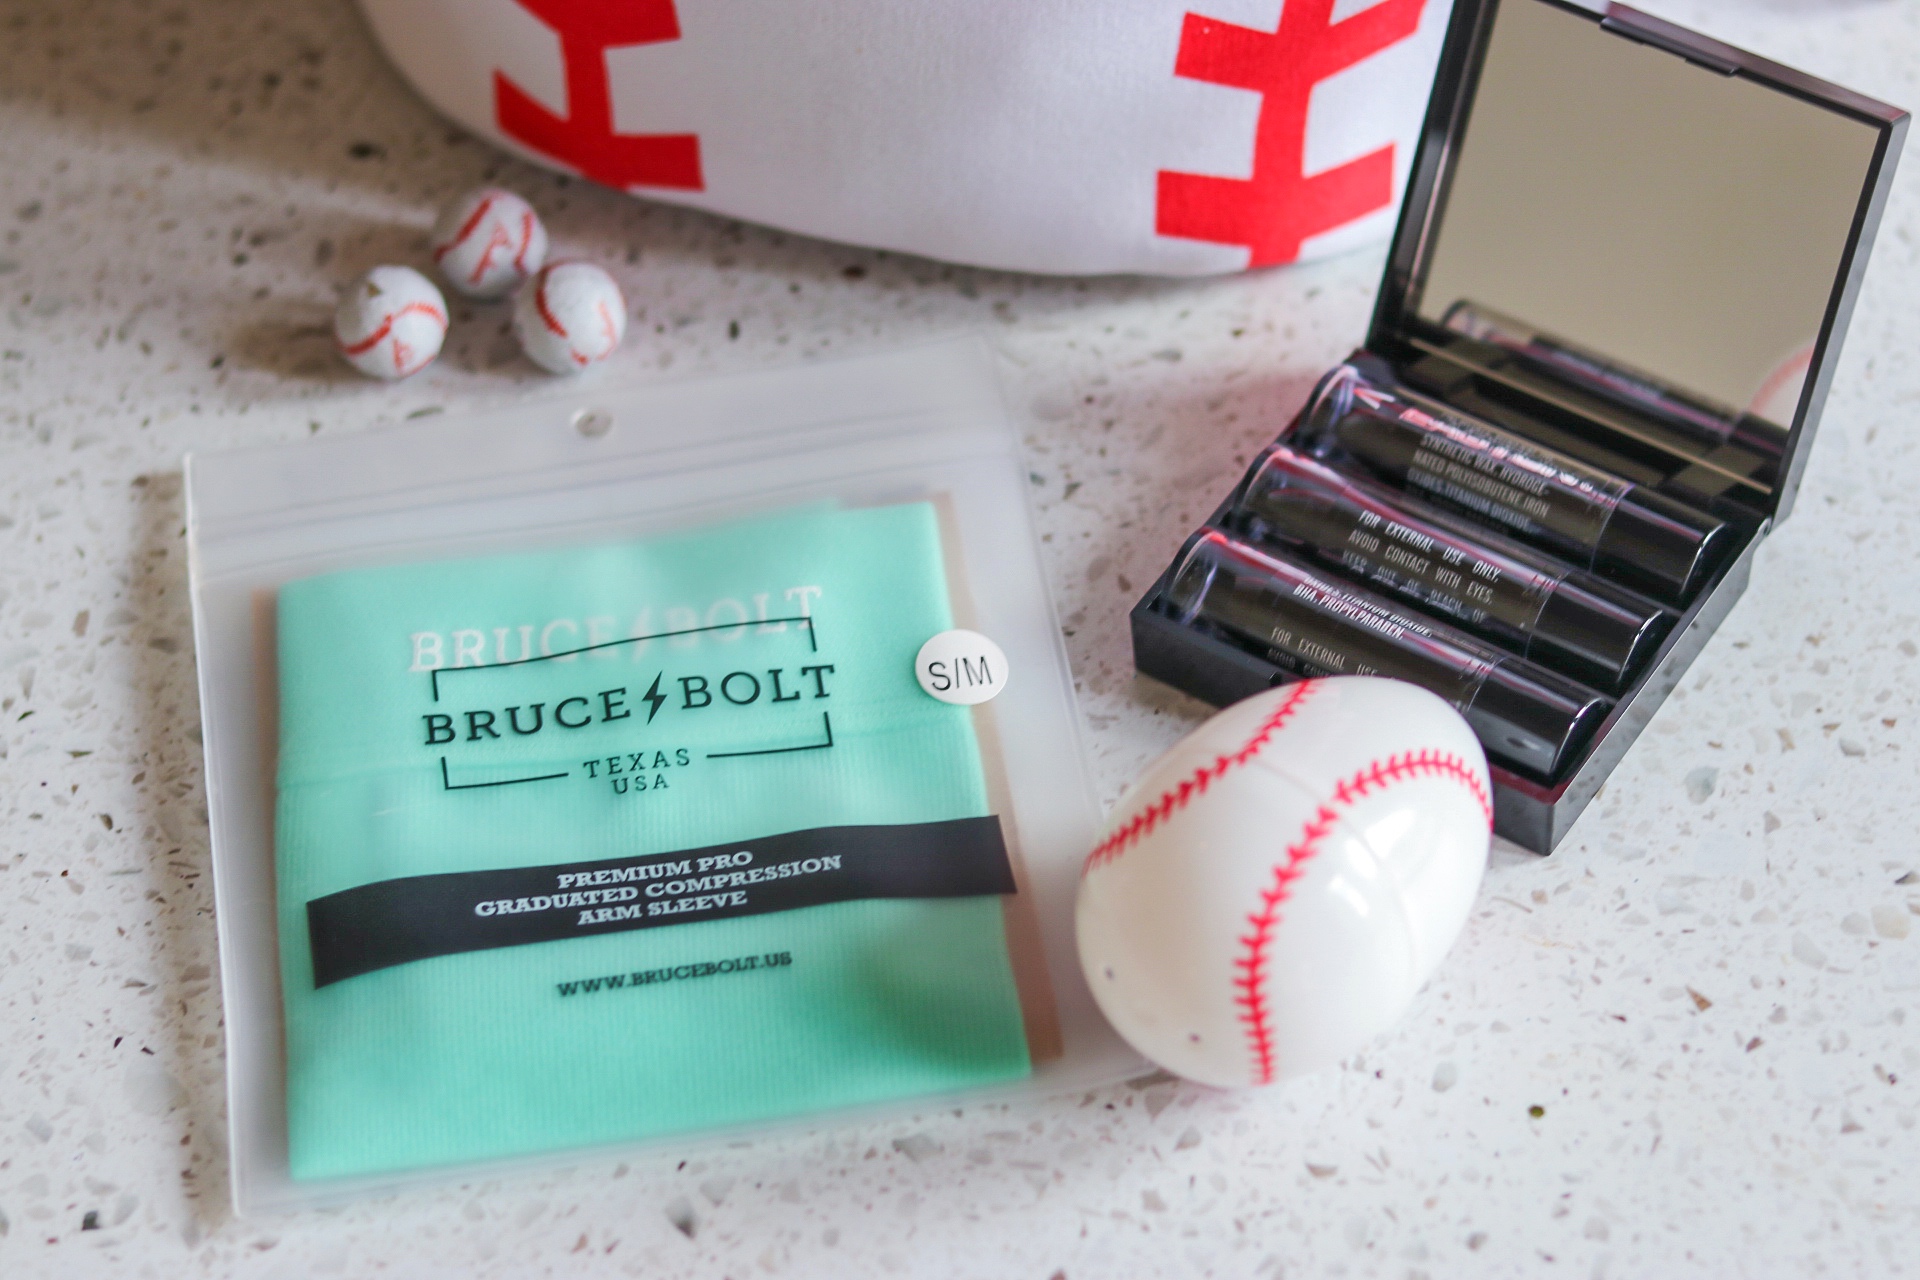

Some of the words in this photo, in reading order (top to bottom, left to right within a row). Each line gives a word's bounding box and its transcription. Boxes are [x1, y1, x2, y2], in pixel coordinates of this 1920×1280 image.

[1348, 528, 1380, 553] AVOID
[1384, 545, 1431, 575] CONTACT
[1434, 565, 1462, 590] WITH
[1358, 510, 1382, 529] FOR
[1384, 520, 1435, 552] EXTERNAL
[1442, 545, 1468, 566] USE
[408, 615, 620, 673] BRUCE
[663, 585, 823, 650] BOLT
[1271, 626, 1293, 647] FOR
[1296, 637, 1346, 671] EXTERNAL
[928, 655, 993, 691] S/M
[422, 686, 631, 745] BRUCE
[677, 664, 835, 710] BOLT
[583, 748, 692, 779] TEXAS
[611, 773, 670, 795] USA
[474, 886, 639, 917] GRADUATED
[644, 854, 843, 899] COMPRESSION
[556, 859, 692, 889] PREMIUM
[696, 850, 754, 873] PRO
[576, 904, 643, 926] ARM
[647, 890, 748, 917] SLEEVE
[556, 951, 793, 998] WWW.BRUCEBOLT.US
